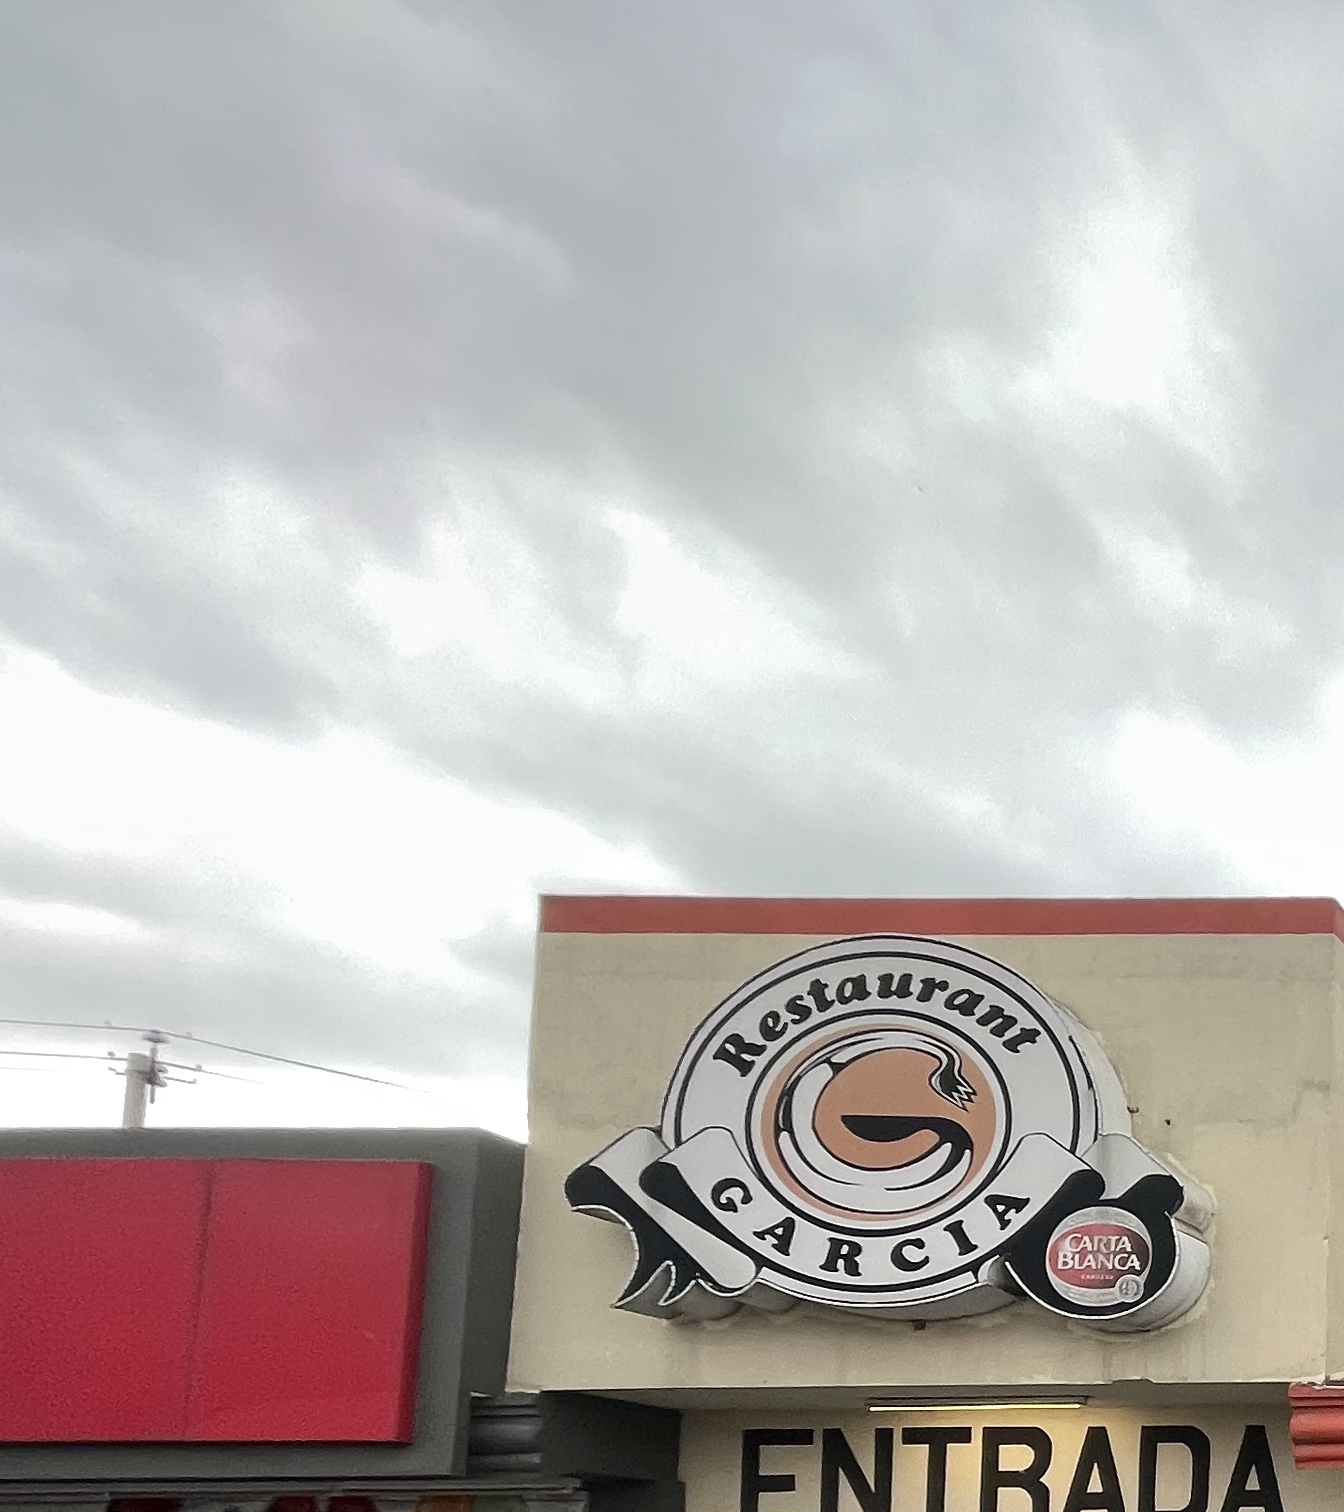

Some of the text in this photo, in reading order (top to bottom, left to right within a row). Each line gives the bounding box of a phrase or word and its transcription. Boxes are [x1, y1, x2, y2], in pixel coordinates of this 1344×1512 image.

[713, 972, 1042, 1078] Restaurant
[711, 1177, 1031, 1277] GARCIA
[1064, 1232, 1133, 1254] CARTA
[1057, 1251, 1141, 1271] BLANCA
